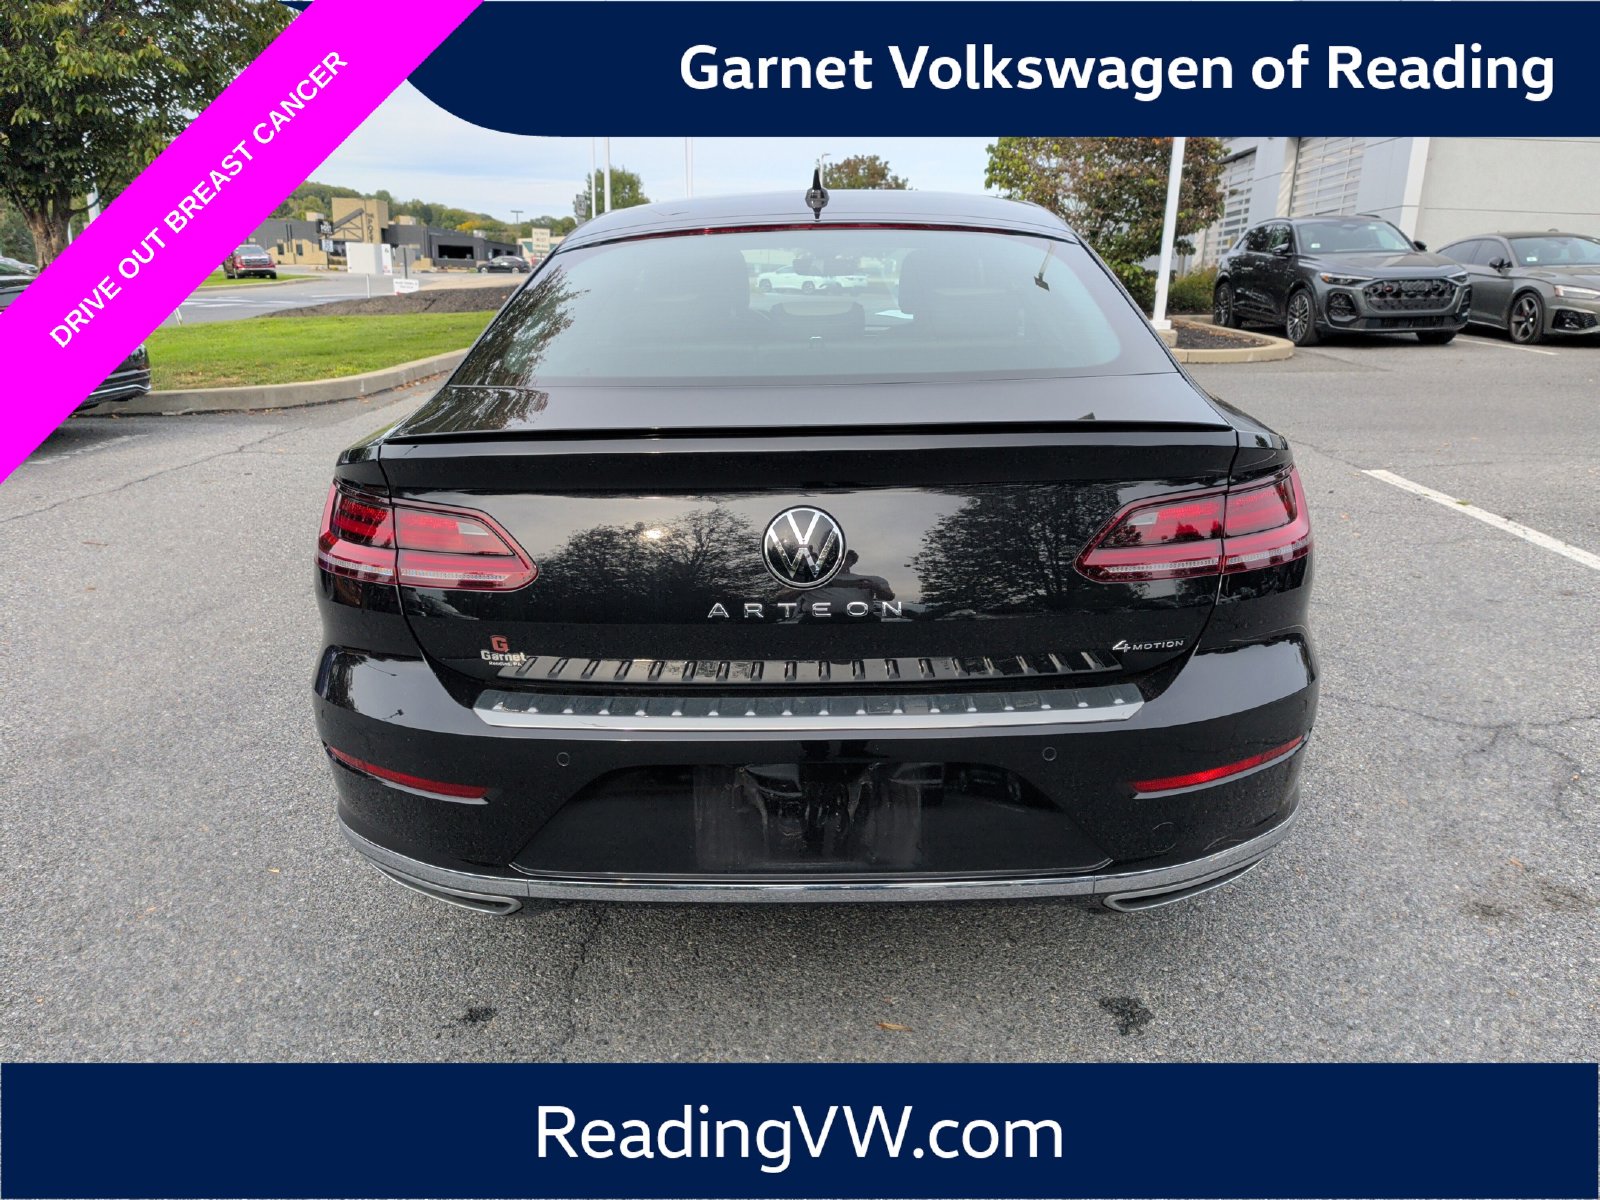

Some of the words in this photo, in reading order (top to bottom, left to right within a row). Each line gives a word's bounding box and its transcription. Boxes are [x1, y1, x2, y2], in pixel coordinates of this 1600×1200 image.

[707, 601, 902, 618] ARTEON
[1112, 639, 1184, 653] 4MOTION
[480, 650, 527, 662] Garnet
